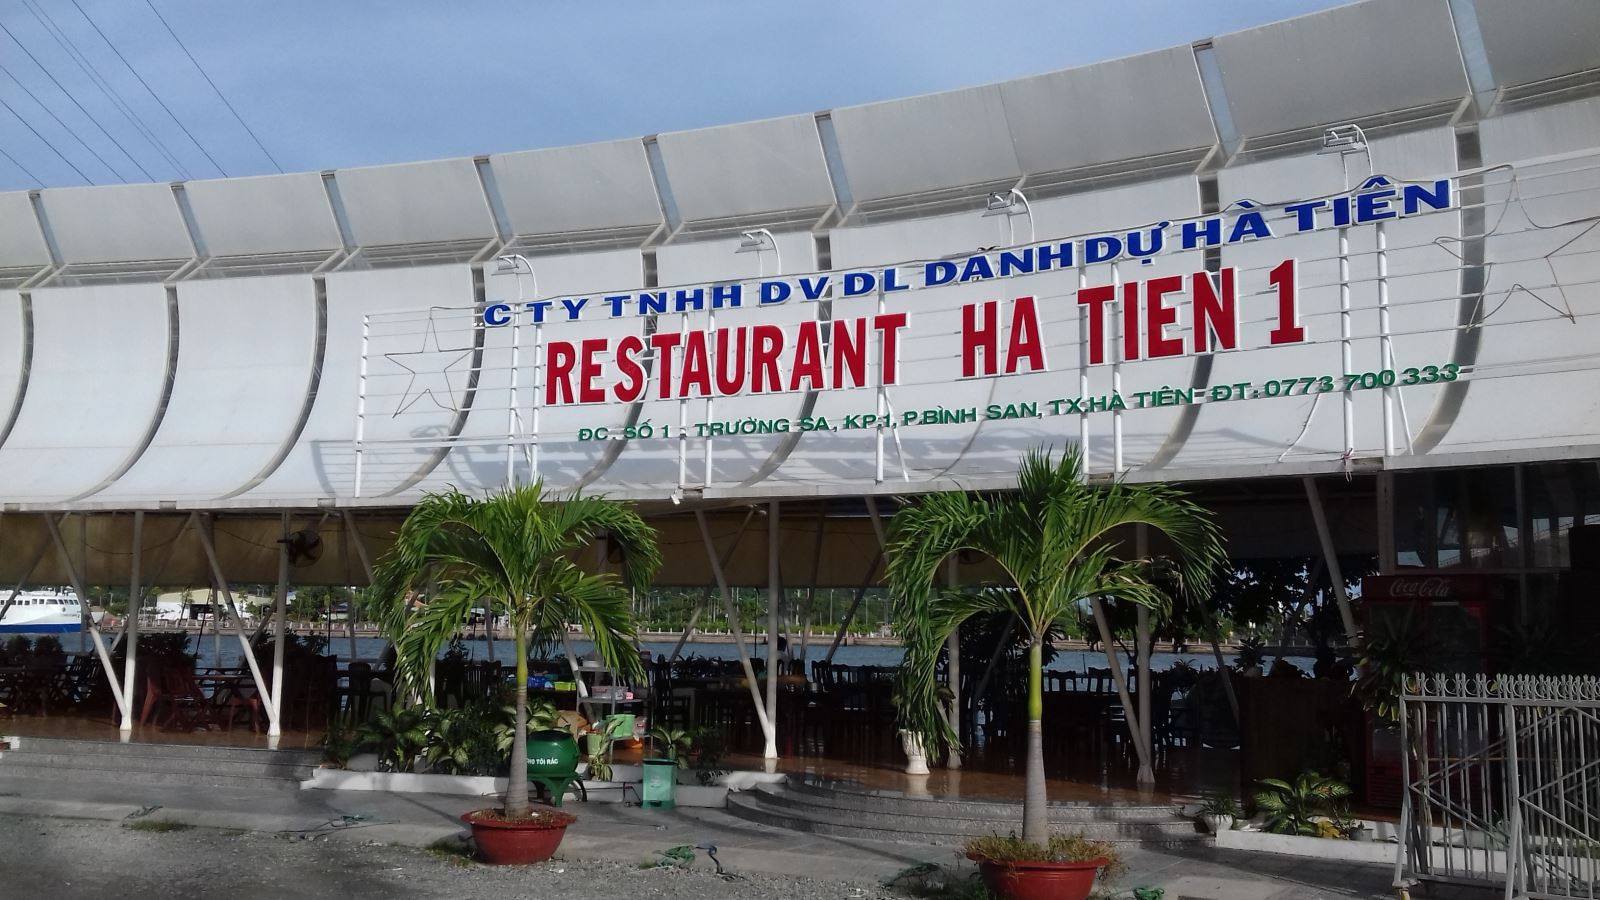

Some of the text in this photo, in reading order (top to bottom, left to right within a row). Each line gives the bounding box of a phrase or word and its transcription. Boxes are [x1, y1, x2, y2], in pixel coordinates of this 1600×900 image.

[604, 284, 742, 317] TNHH
[1182, 200, 1271, 249] HÀ
[1285, 176, 1450, 232] TIÊN
[545, 259, 1305, 406] RESTAURANT HA TIEN 1
[624, 418, 654, 439] SỐ
[694, 416, 790, 437] TRƯỜNG
[1345, 369, 1396, 391] 700
[1402, 363, 1460, 386] 333
